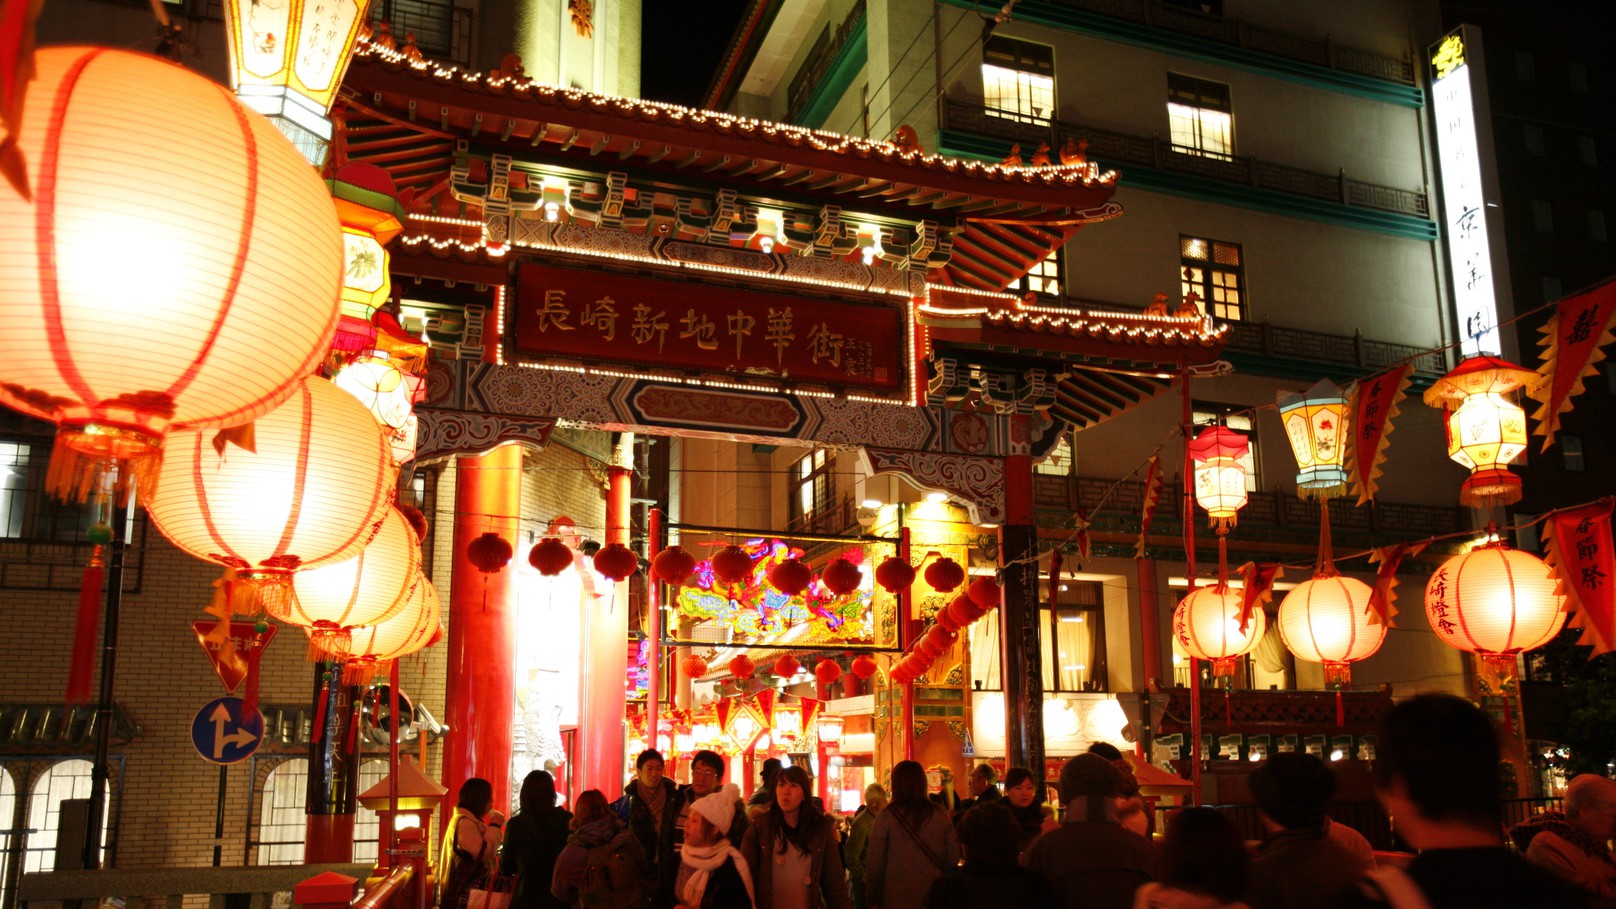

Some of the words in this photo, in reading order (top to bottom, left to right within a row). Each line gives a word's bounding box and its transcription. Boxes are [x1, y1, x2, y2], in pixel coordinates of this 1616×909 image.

[534, 288, 842, 369] 長崎新地中華街
[1574, 516, 1609, 590] 春節祭
